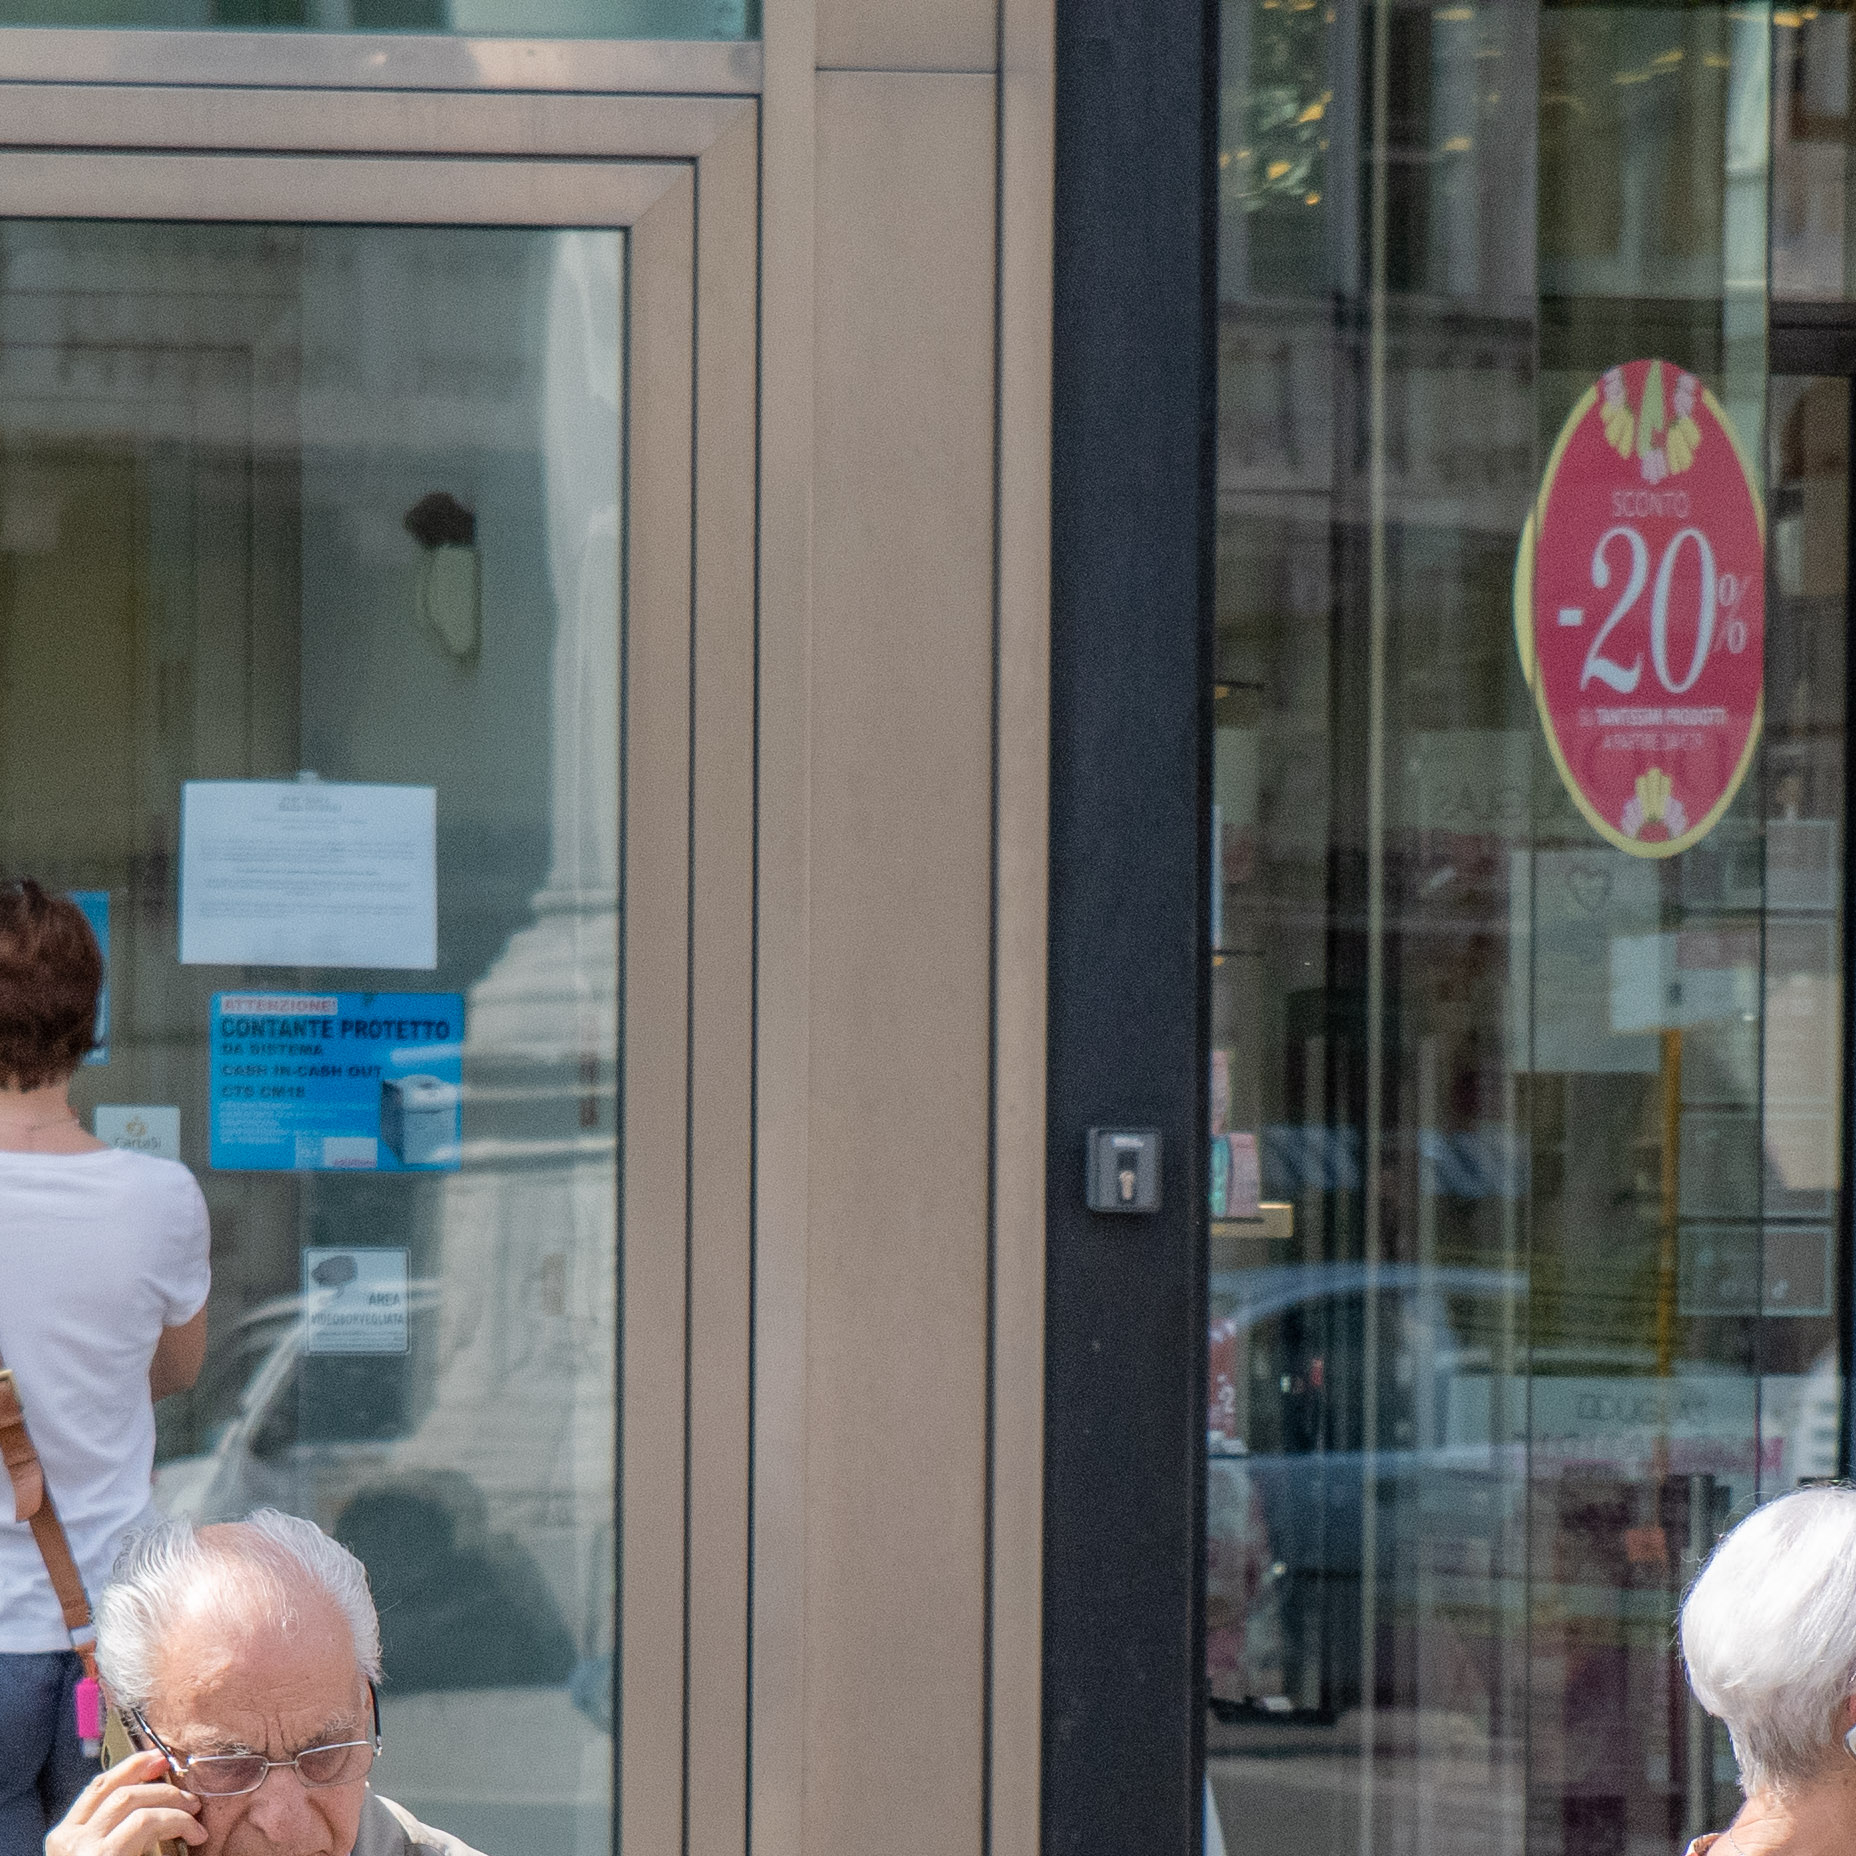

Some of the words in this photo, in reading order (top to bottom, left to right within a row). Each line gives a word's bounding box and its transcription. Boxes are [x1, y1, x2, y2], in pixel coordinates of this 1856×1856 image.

[1612, 491, 1690, 518] SCONTO
[224, 998, 335, 1012] ATTENZIONE!
[221, 1018, 333, 1039] CONTANTE
[340, 1020, 451, 1040] PROTETTO
[249, 1044, 323, 1056] SISTEMA
[222, 1065, 267, 1077] CASH
[347, 1066, 383, 1078] OUT
[368, 1292, 400, 1306] AREA
